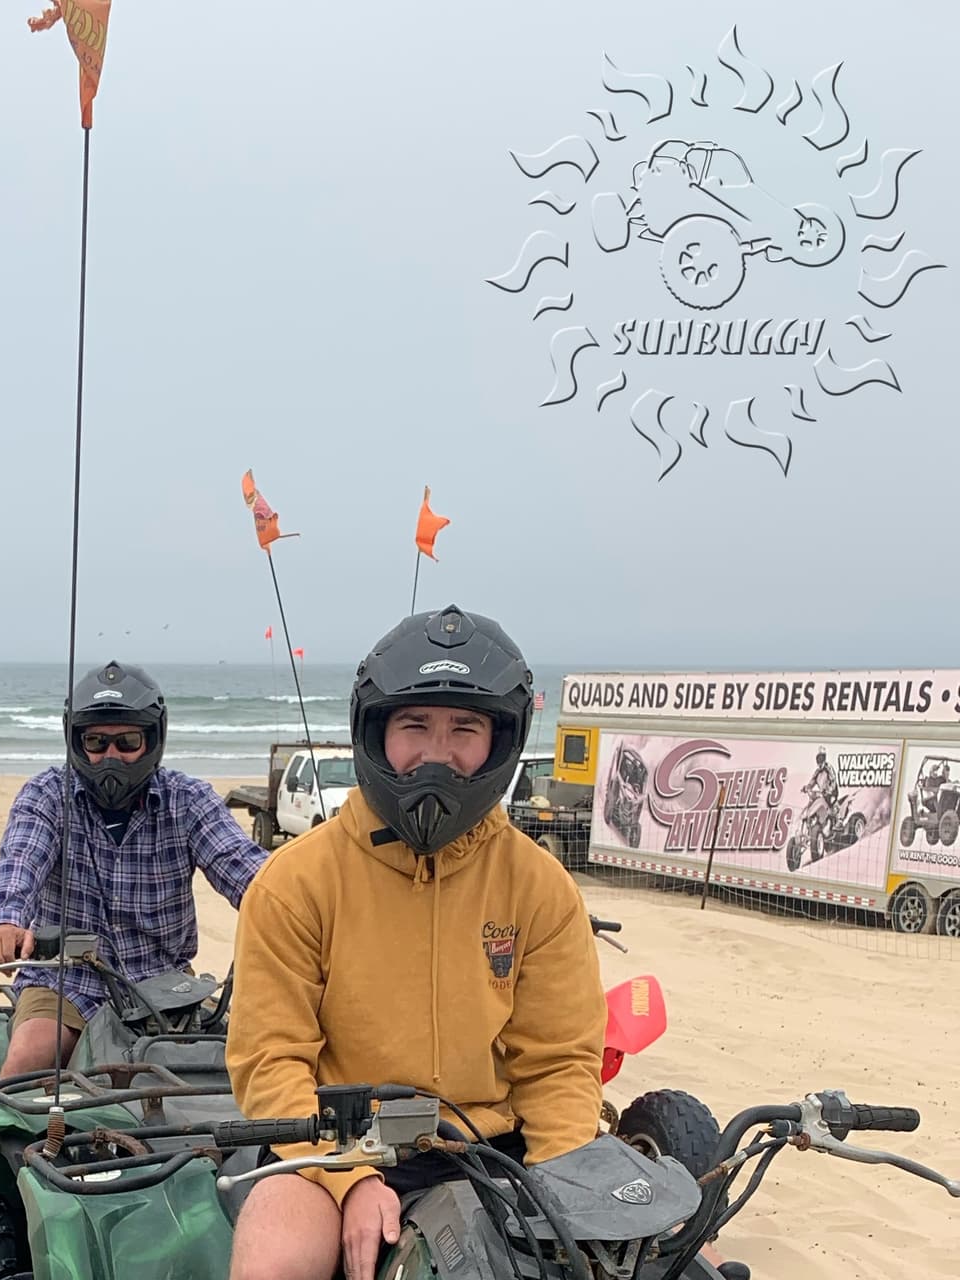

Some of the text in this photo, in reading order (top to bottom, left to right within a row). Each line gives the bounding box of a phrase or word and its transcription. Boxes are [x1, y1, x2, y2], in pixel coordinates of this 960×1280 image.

[568, 682, 624, 709] QUADS
[628, 682, 668, 709] AND
[673, 682, 717, 710] SIDE
[721, 682, 749, 711] BY
[752, 682, 815, 711] SIDES
[822, 680, 933, 713] RENTALS
[839, 754, 895, 770] WALK-UPS
[839, 770, 892, 787] WELCOME
[665, 811, 708, 851] ATV
[937, 855, 957, 867] GOOD
[436, 1226, 463, 1270] YAMAHA
